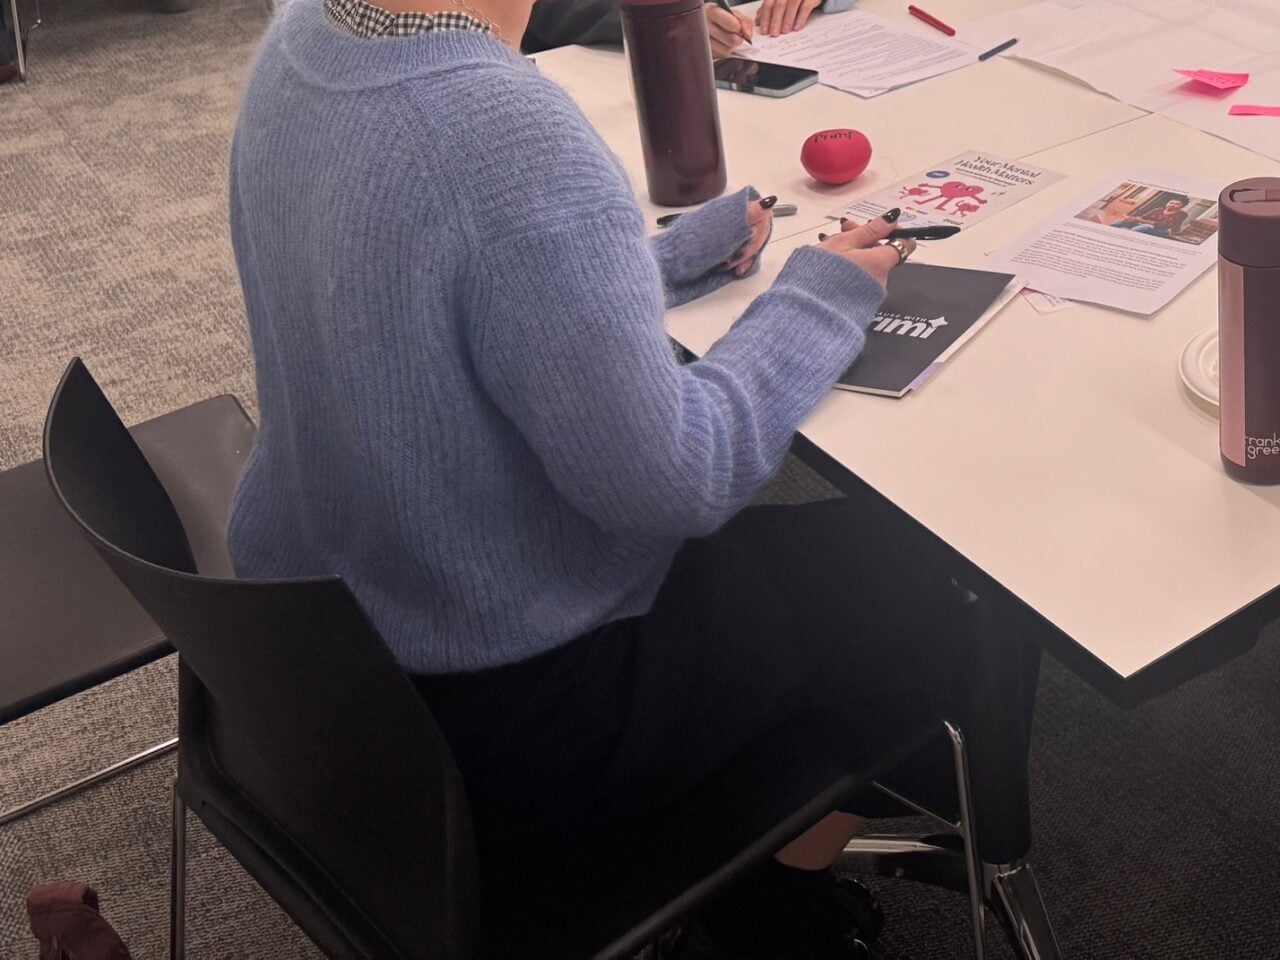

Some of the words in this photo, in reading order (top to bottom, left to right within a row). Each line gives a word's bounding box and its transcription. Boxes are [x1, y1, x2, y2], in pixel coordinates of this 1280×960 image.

[954, 160, 991, 175] Health
[991, 169, 1035, 185] Matters
[975, 156, 1000, 167] Your
[1000, 163, 1042, 178] Mental
